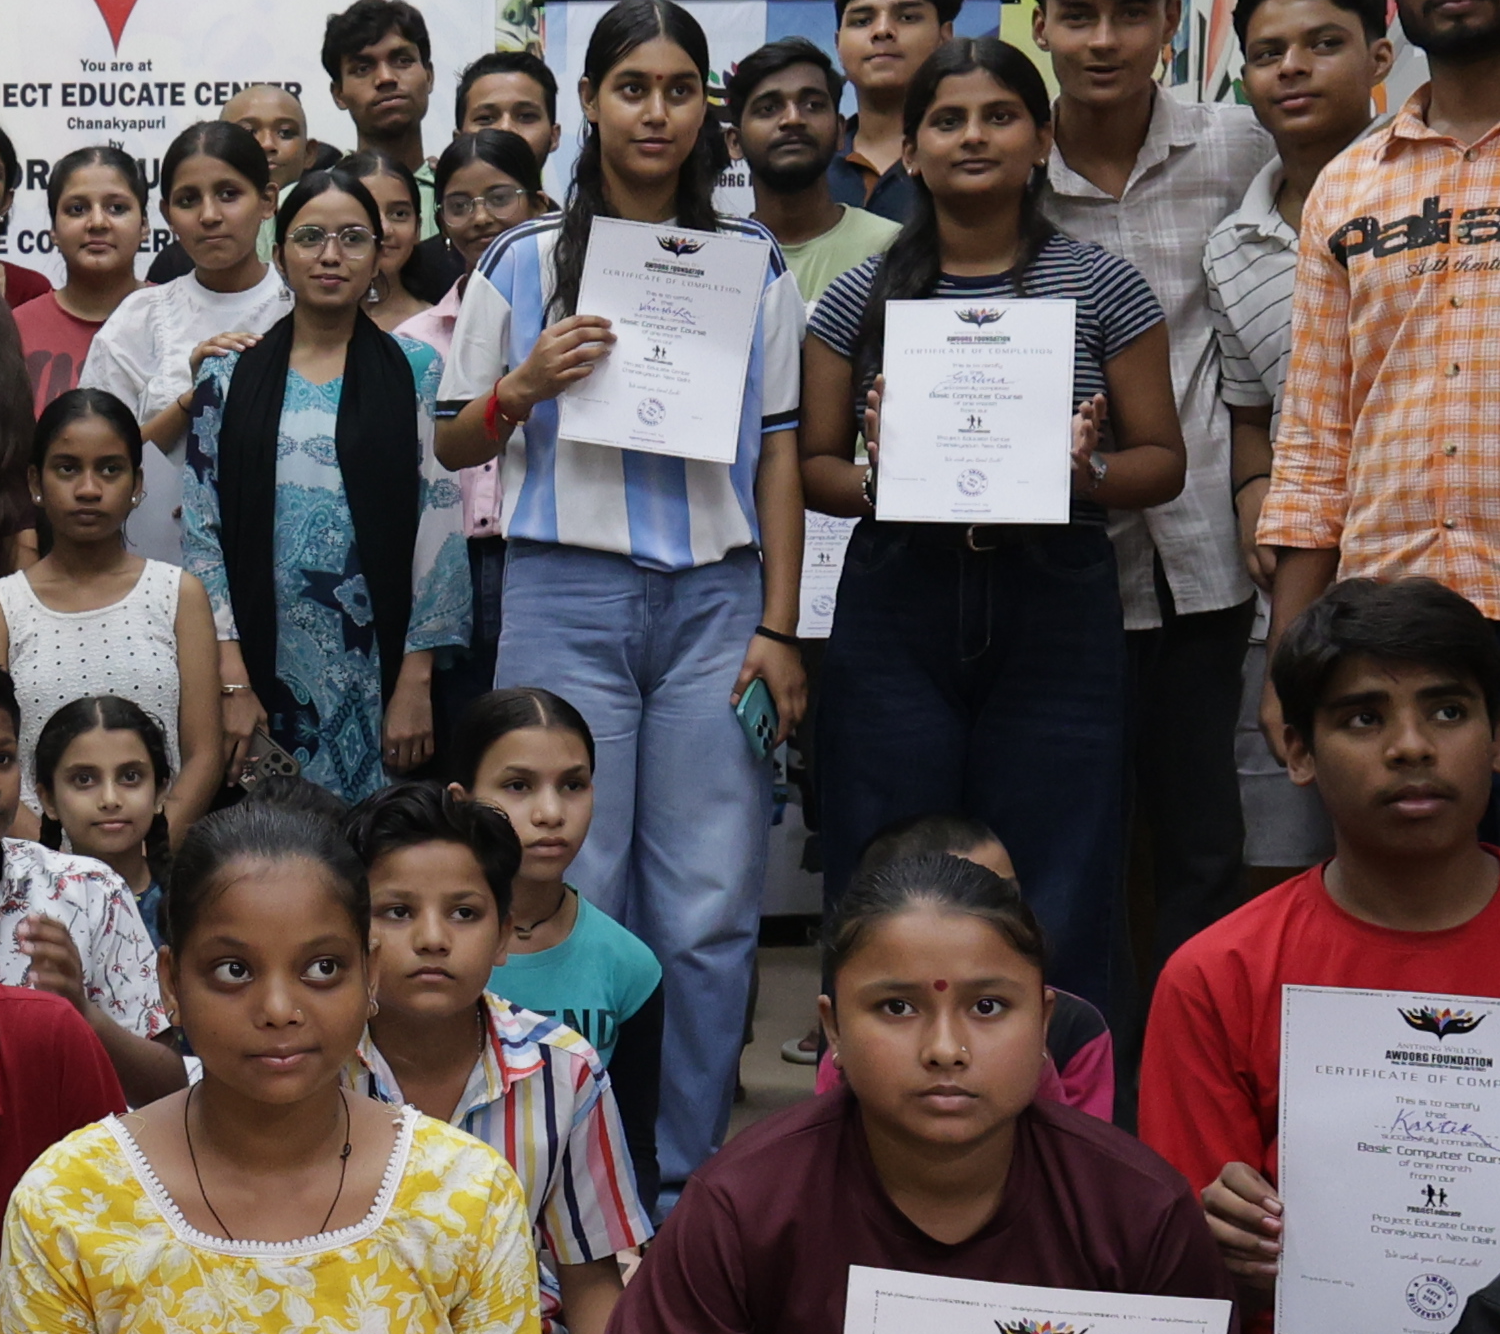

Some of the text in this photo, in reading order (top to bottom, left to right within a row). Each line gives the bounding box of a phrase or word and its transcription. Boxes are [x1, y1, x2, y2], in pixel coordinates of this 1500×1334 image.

[80, 59, 153, 72] You are at
[61, 82, 185, 107] EDUCATE
[67, 117, 165, 132] Chanakyapuri
[1385, 1050, 1429, 1063] AWDORG
[1431, 1053, 1493, 1067] FOUNDATION
[1315, 1065, 1419, 1082] CERTIFICATE
[1428, 1074, 1448, 1084] OF
[1357, 1142, 1391, 1154] Basic
[1397, 1145, 1462, 1161] Computer
